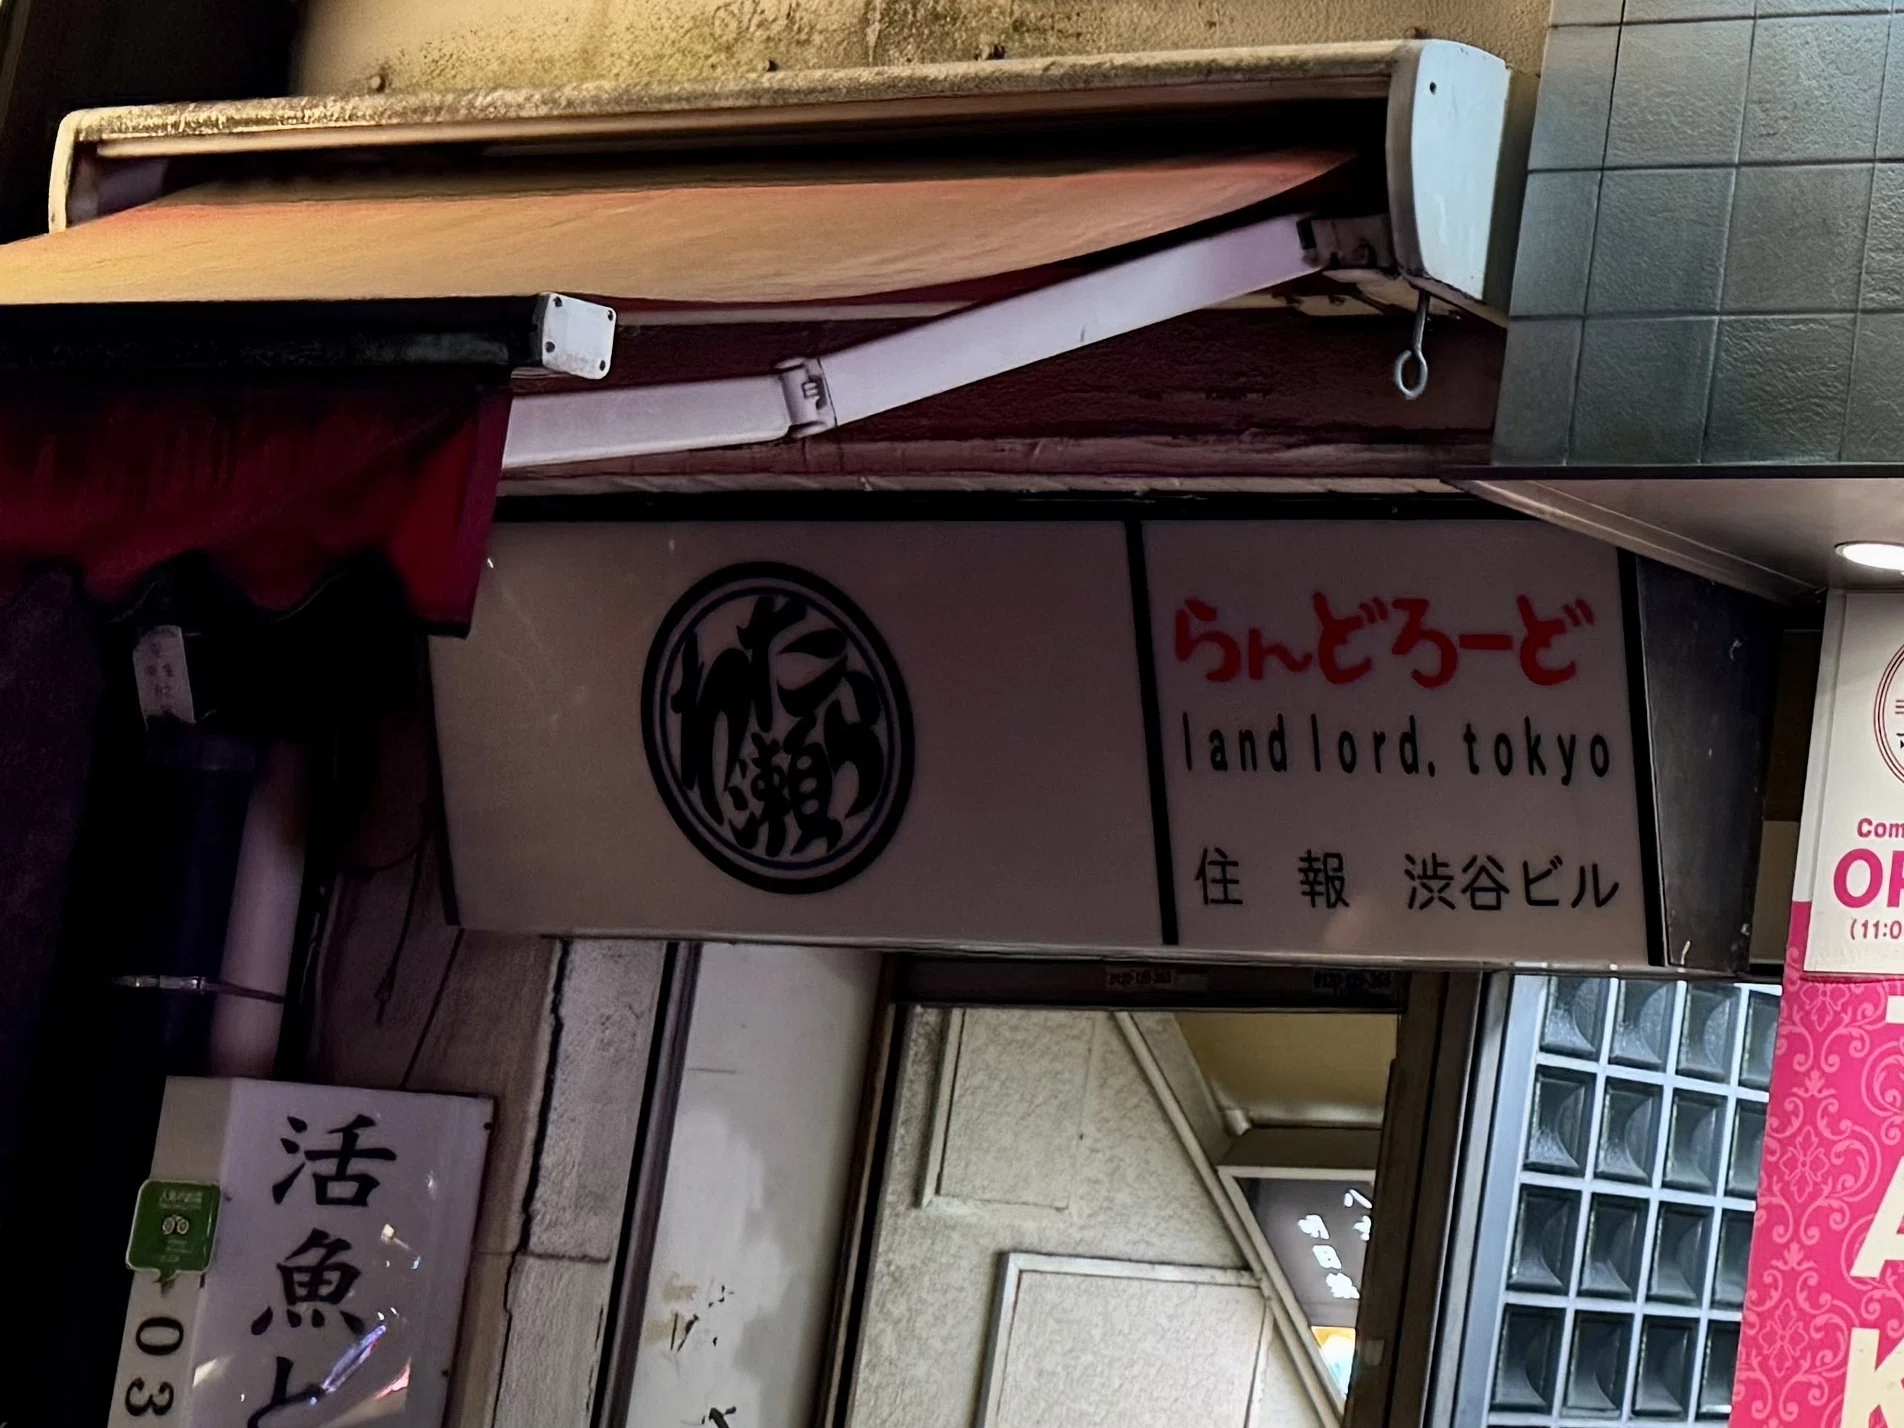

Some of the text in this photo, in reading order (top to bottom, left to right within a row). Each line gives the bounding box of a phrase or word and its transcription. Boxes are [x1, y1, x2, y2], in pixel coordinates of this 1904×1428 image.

[1173, 589, 1594, 689] らんどろーど
[1403, 852, 1621, 913] 渋谷ビル
